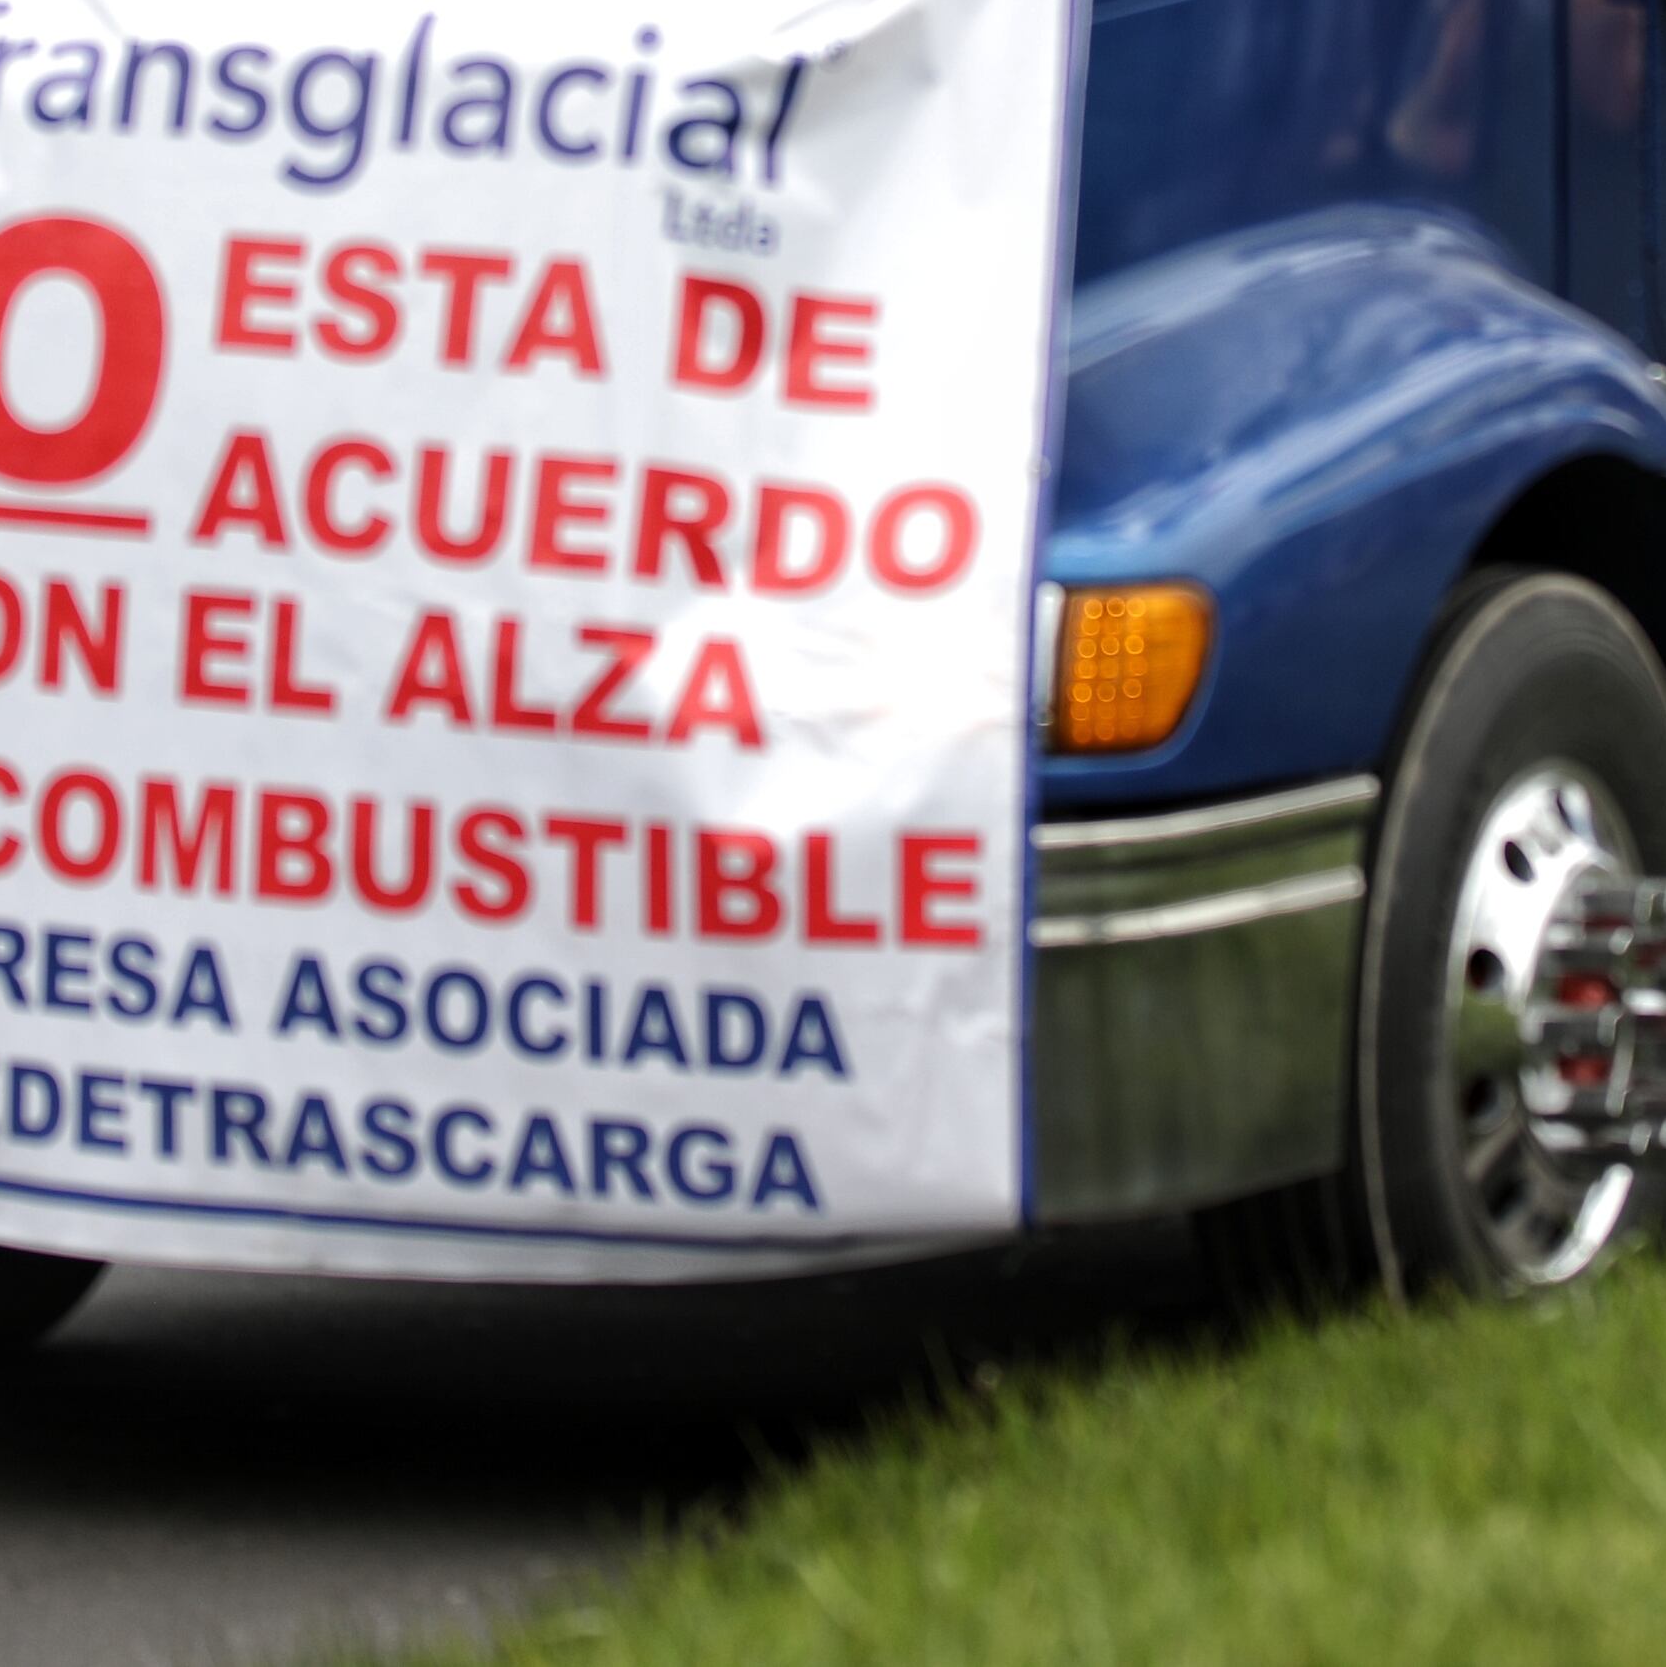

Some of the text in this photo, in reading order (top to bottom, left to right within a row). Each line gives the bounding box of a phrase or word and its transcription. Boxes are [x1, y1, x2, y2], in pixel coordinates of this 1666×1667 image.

[213, 234, 607, 378] ESTA
[671, 272, 879, 411] DE
[191, 429, 980, 597] ACUERDO
[179, 590, 338, 715] EL
[384, 609, 768, 751] ALZA
[274, 954, 851, 1082] ASOCIADA
